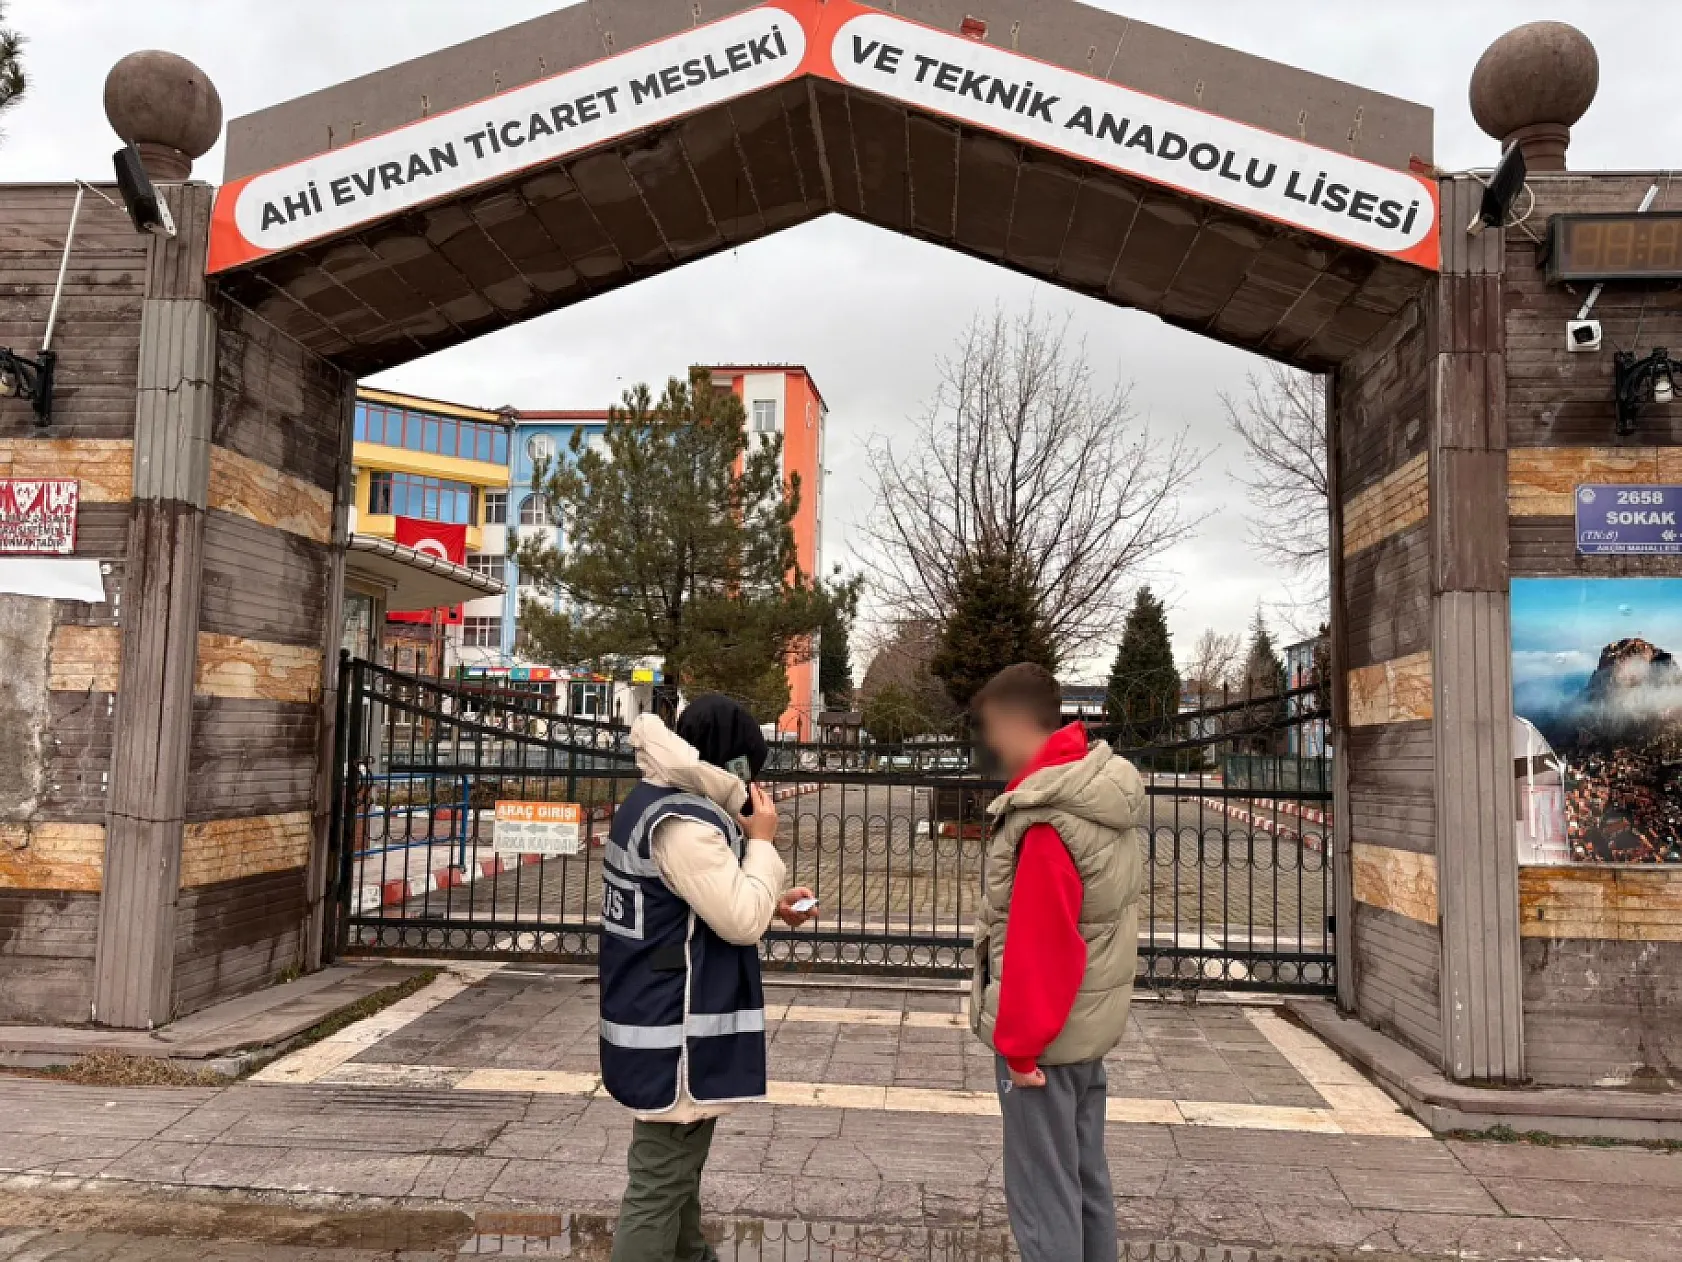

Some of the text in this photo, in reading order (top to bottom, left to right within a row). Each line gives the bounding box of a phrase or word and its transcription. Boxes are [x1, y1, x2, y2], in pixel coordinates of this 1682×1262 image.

[260, 23, 789, 231] AHİ EVRAN TİCARET MESLEKİ
[852, 34, 1420, 235] VE TEKNİK ANADOLU LİSESİ
[1605, 510, 1676, 525] SOKAK
[1616, 490, 1664, 505] 2658
